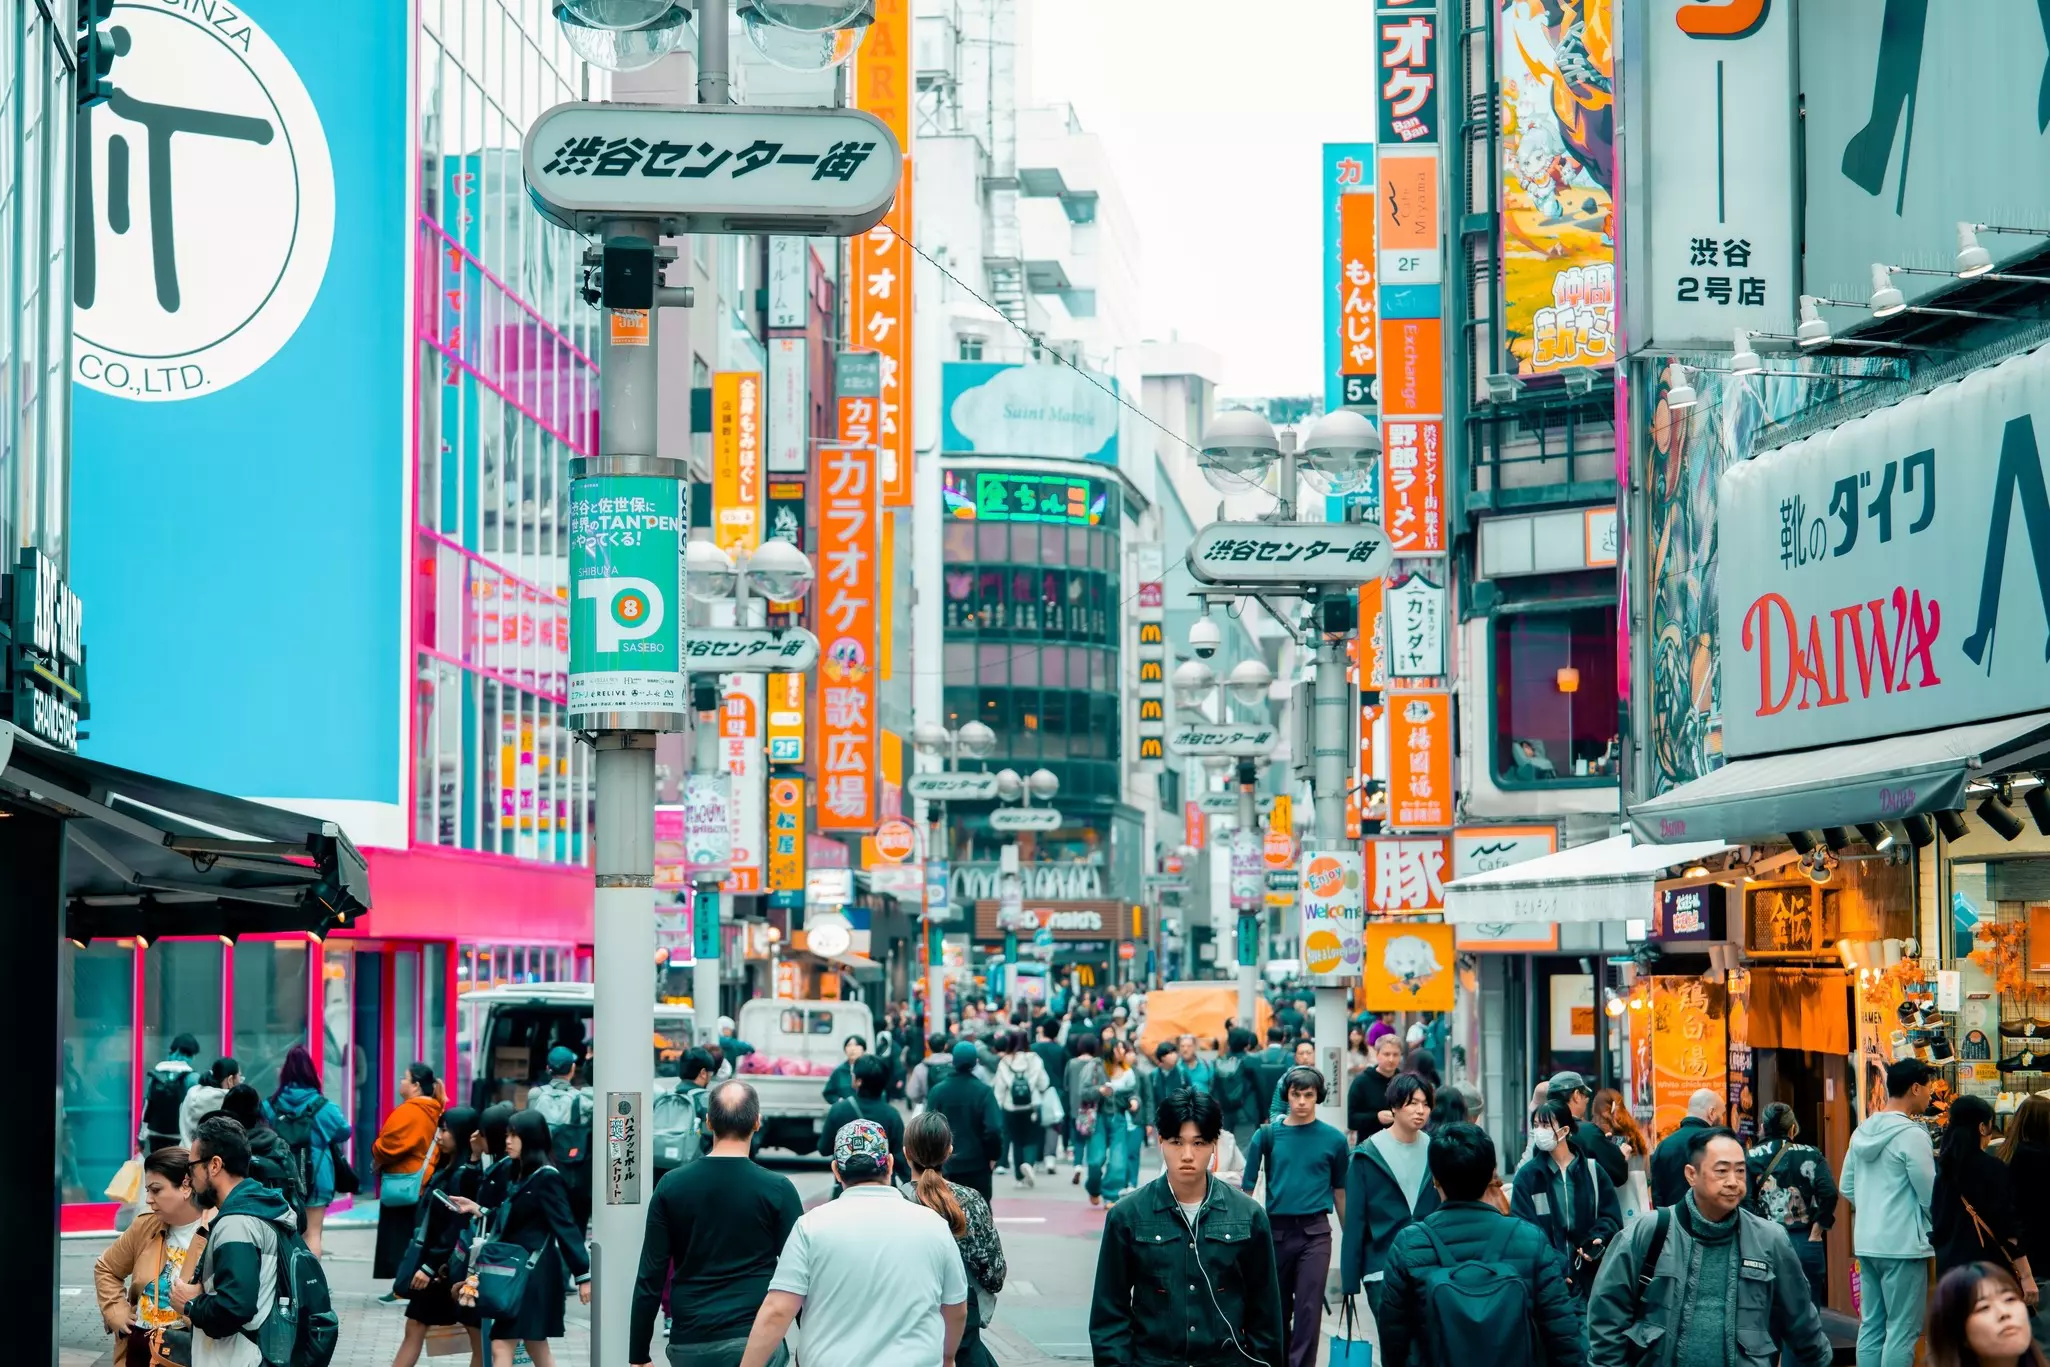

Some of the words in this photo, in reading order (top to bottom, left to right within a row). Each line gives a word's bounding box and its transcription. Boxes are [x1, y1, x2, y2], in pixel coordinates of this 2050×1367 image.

[163, 0, 252, 53] NZA
[1392, 116, 1420, 133] Ban
[1400, 124, 1429, 141] Ban
[543, 136, 876, 181] 渋谷センター街
[1398, 257, 1420, 271] 2F
[1690, 238, 1752, 268] 渋谷
[1677, 276, 1766, 306] 2号店
[1345, 259, 1375, 367] もんじゃ
[79, 353, 212, 395] CO.,LTD.
[1402, 323, 1419, 410] Exchange
[1389, 423, 1418, 548] 野郎ラーメン
[1779, 447, 1936, 570] 靴のダイワ
[825, 451, 869, 632] カラオケ
[1204, 539, 1380, 563] 渋谷センター街
[578, 566, 619, 577] SHIBUYA
[34, 548, 83, 668] ABC-MART
[622, 643, 665, 652] SASEBO
[1407, 600, 1424, 669] カンダヤ
[1741, 585, 1942, 717] DAIWA
[775, 742, 797, 756] 2F
[824, 687, 869, 819] 歌広場
[1173, 731, 1273, 745] 渋谷センター街
[776, 811, 797, 855] 松屋
[1309, 867, 1343, 891] Enjoy
[1374, 839, 1445, 910] 豚
[996, 909, 1103, 931] Dnald's
[1305, 903, 1362, 920] Welcome
[1678, 980, 1709, 1077] 鶏白湯
[1682, 1081, 1711, 1089] chicken
[624, 1115, 635, 1181] バスケットボール
[1748, 1141, 1774, 1157] MY
[613, 1158, 622, 1198] ストリート
